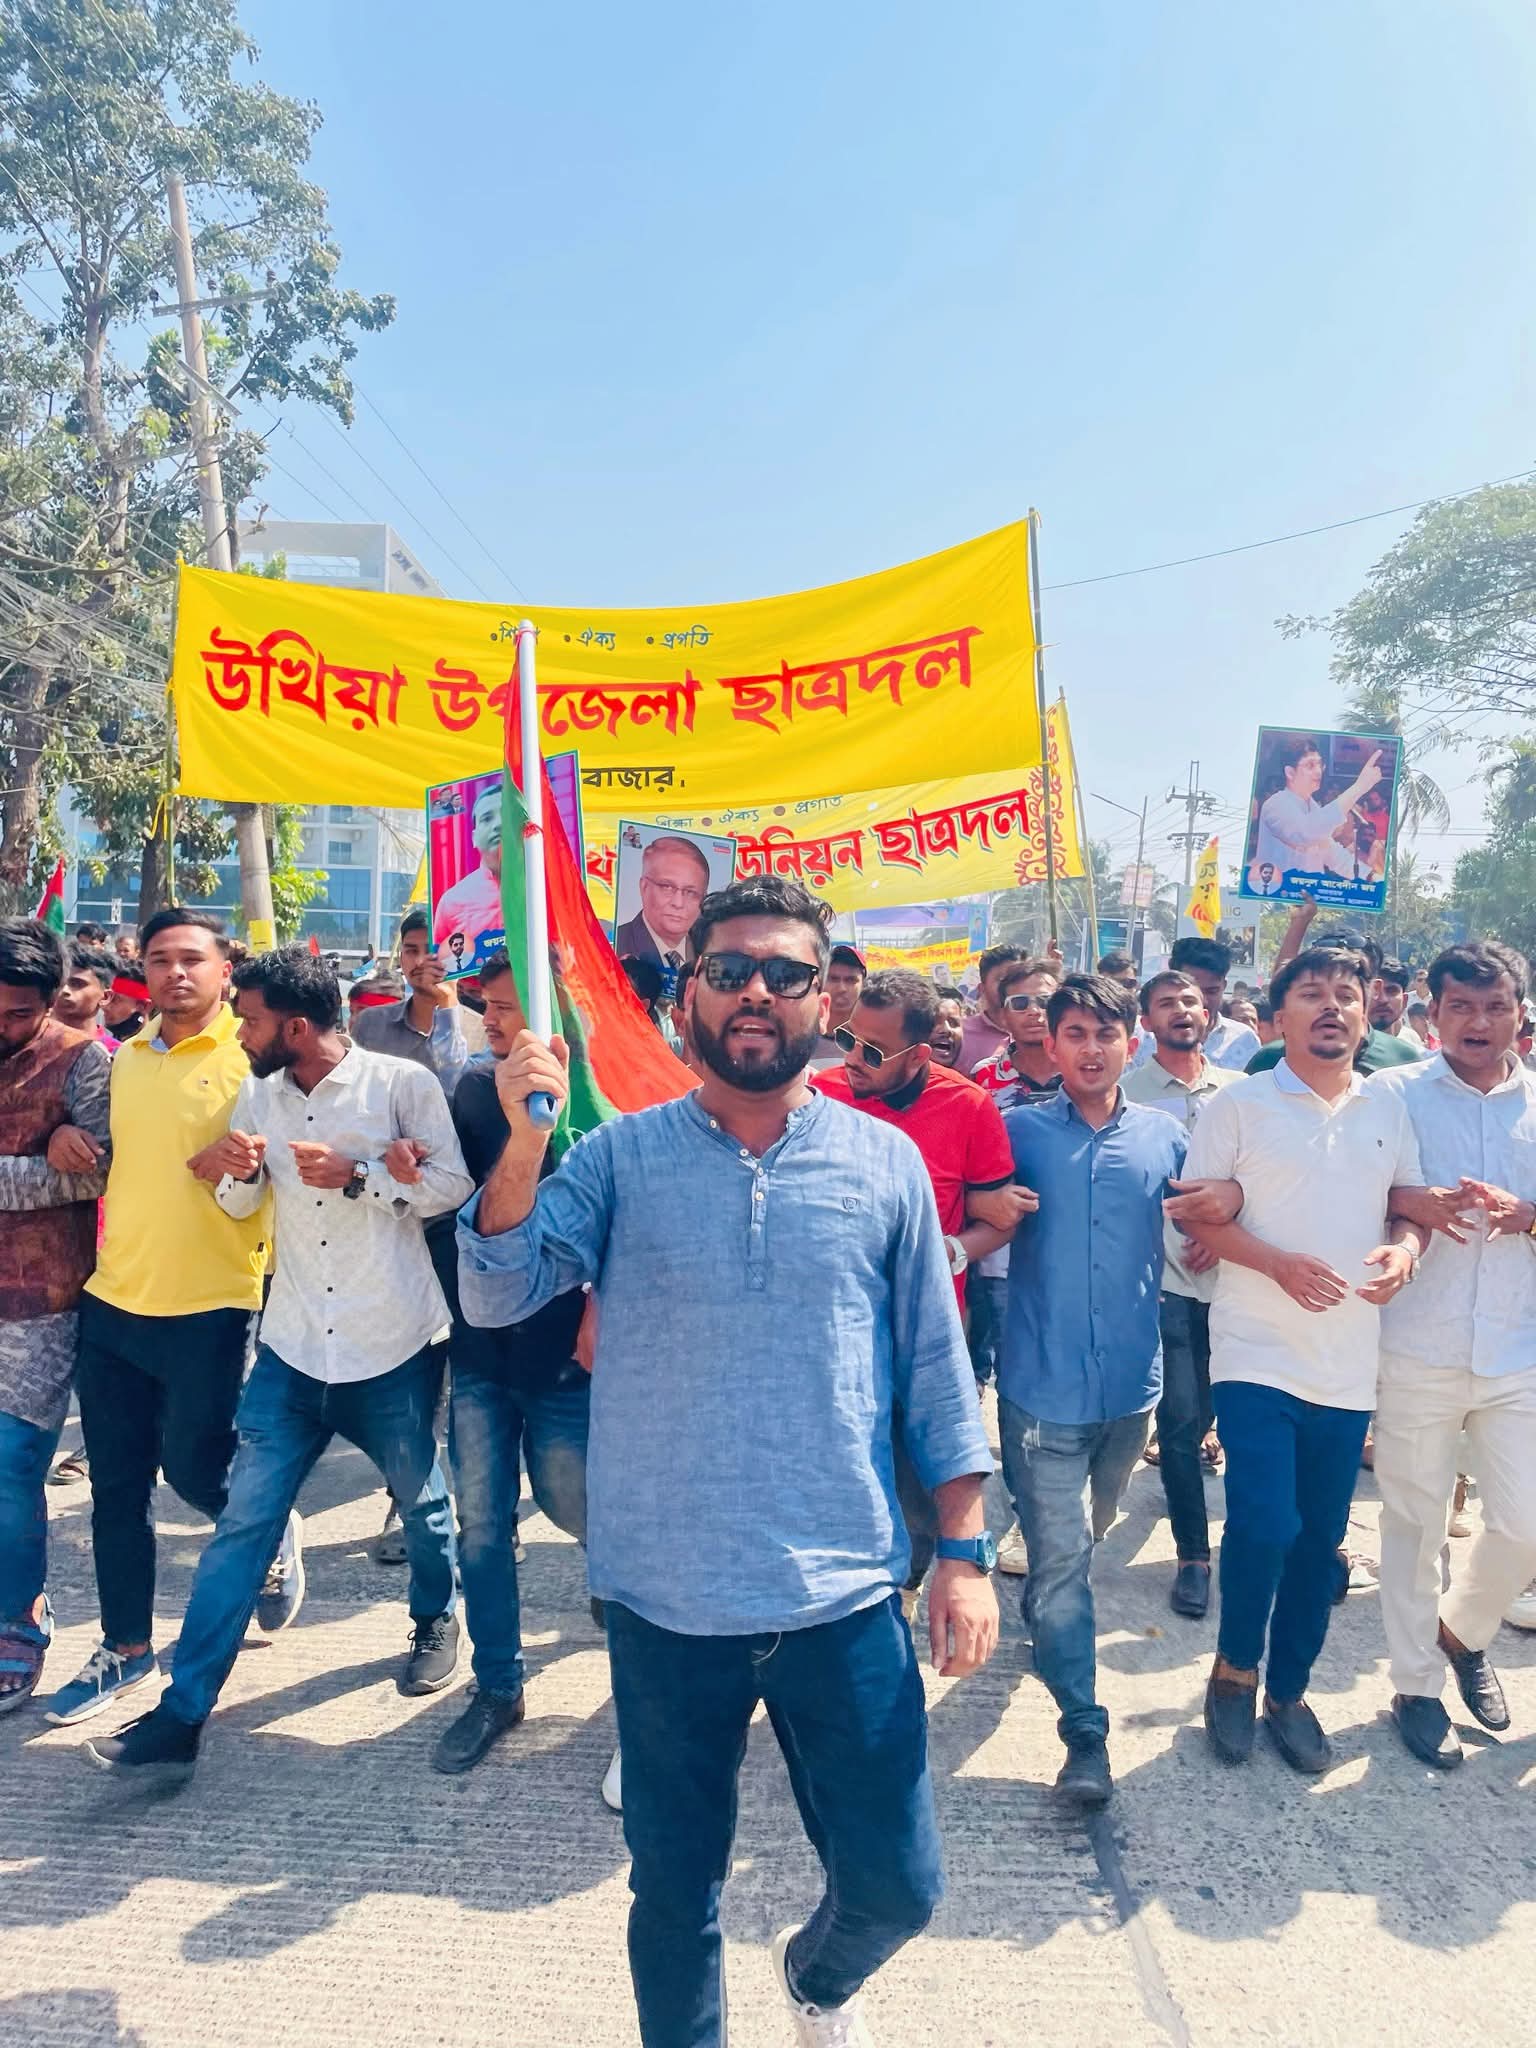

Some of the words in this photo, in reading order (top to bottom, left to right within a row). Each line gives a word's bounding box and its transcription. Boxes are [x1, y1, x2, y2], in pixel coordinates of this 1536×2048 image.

[576, 627, 616, 651] ঐক্য
[660, 624, 714, 650] প্রগতি
[200, 626, 407, 731] উখিয়া
[715, 626, 984, 735] ছাত্রদল
[719, 808, 760, 823] ঐক্য
[869, 787, 1033, 873] ছাত্রদল
